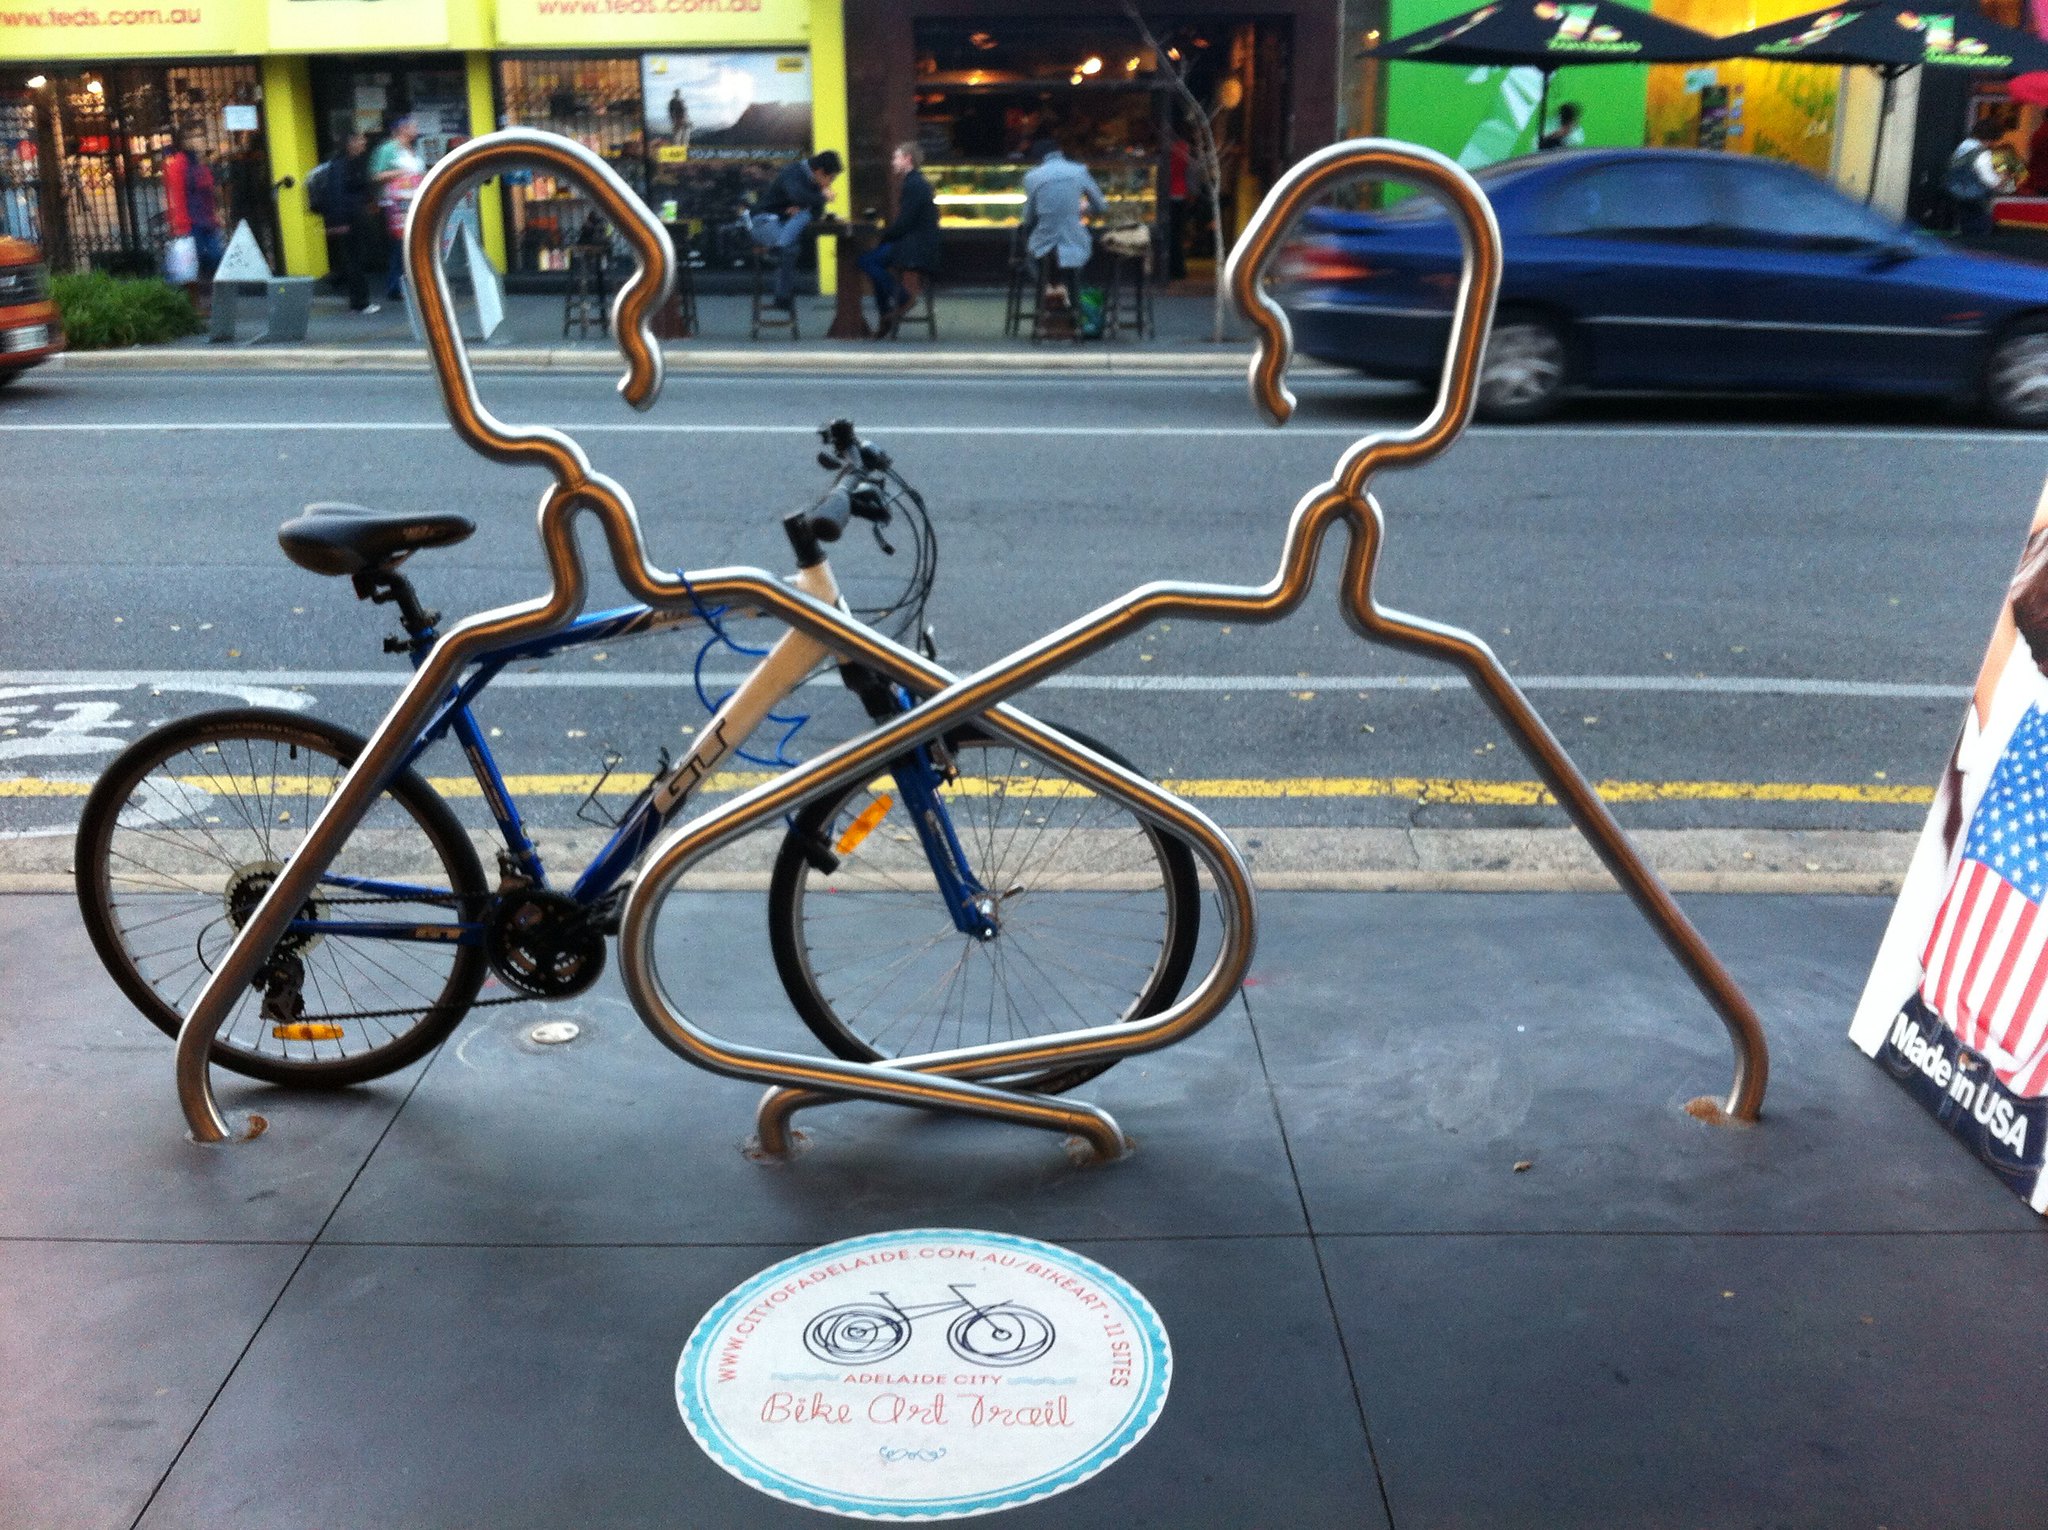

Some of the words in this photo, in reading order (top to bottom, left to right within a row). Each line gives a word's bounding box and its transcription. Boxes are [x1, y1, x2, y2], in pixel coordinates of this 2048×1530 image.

[0, 8, 201, 27] ww.teds.com.au
[1890, 1011, 1952, 1088] Made
[1950, 1063, 1976, 1111] in
[1973, 1083, 2028, 1160] USA
[843, 1373, 947, 1385] ADELAIDE
[953, 1373, 1003, 1385] CITY
[1109, 1340, 1132, 1388] SITES
[761, 1391, 853, 1425] Bike
[867, 1392, 948, 1426] Art
[956, 1393, 1075, 1427] Trail
